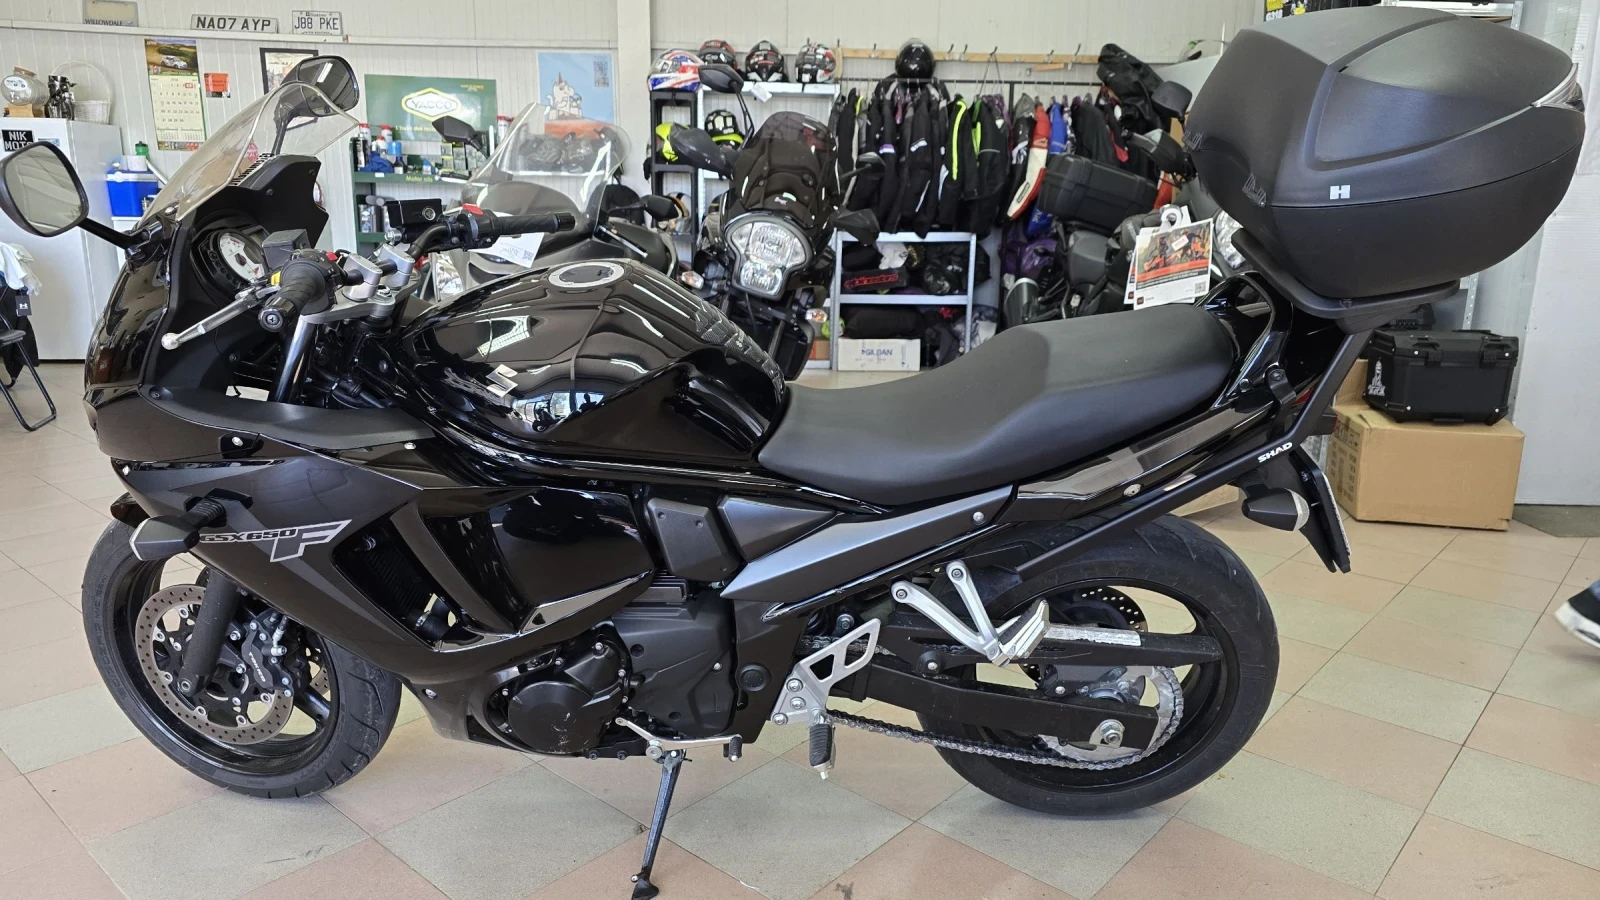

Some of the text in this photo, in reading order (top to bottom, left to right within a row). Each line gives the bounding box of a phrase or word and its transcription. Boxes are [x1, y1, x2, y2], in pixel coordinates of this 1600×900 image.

[196, 17, 271, 31] NA07 AYP
[294, 16, 339, 30] J88 PKE
[411, 100, 453, 110] YACCO
[8, 131, 27, 140] NIK
[1257, 442, 1293, 463] SHAD
[248, 651, 266, 682] TOKICO
